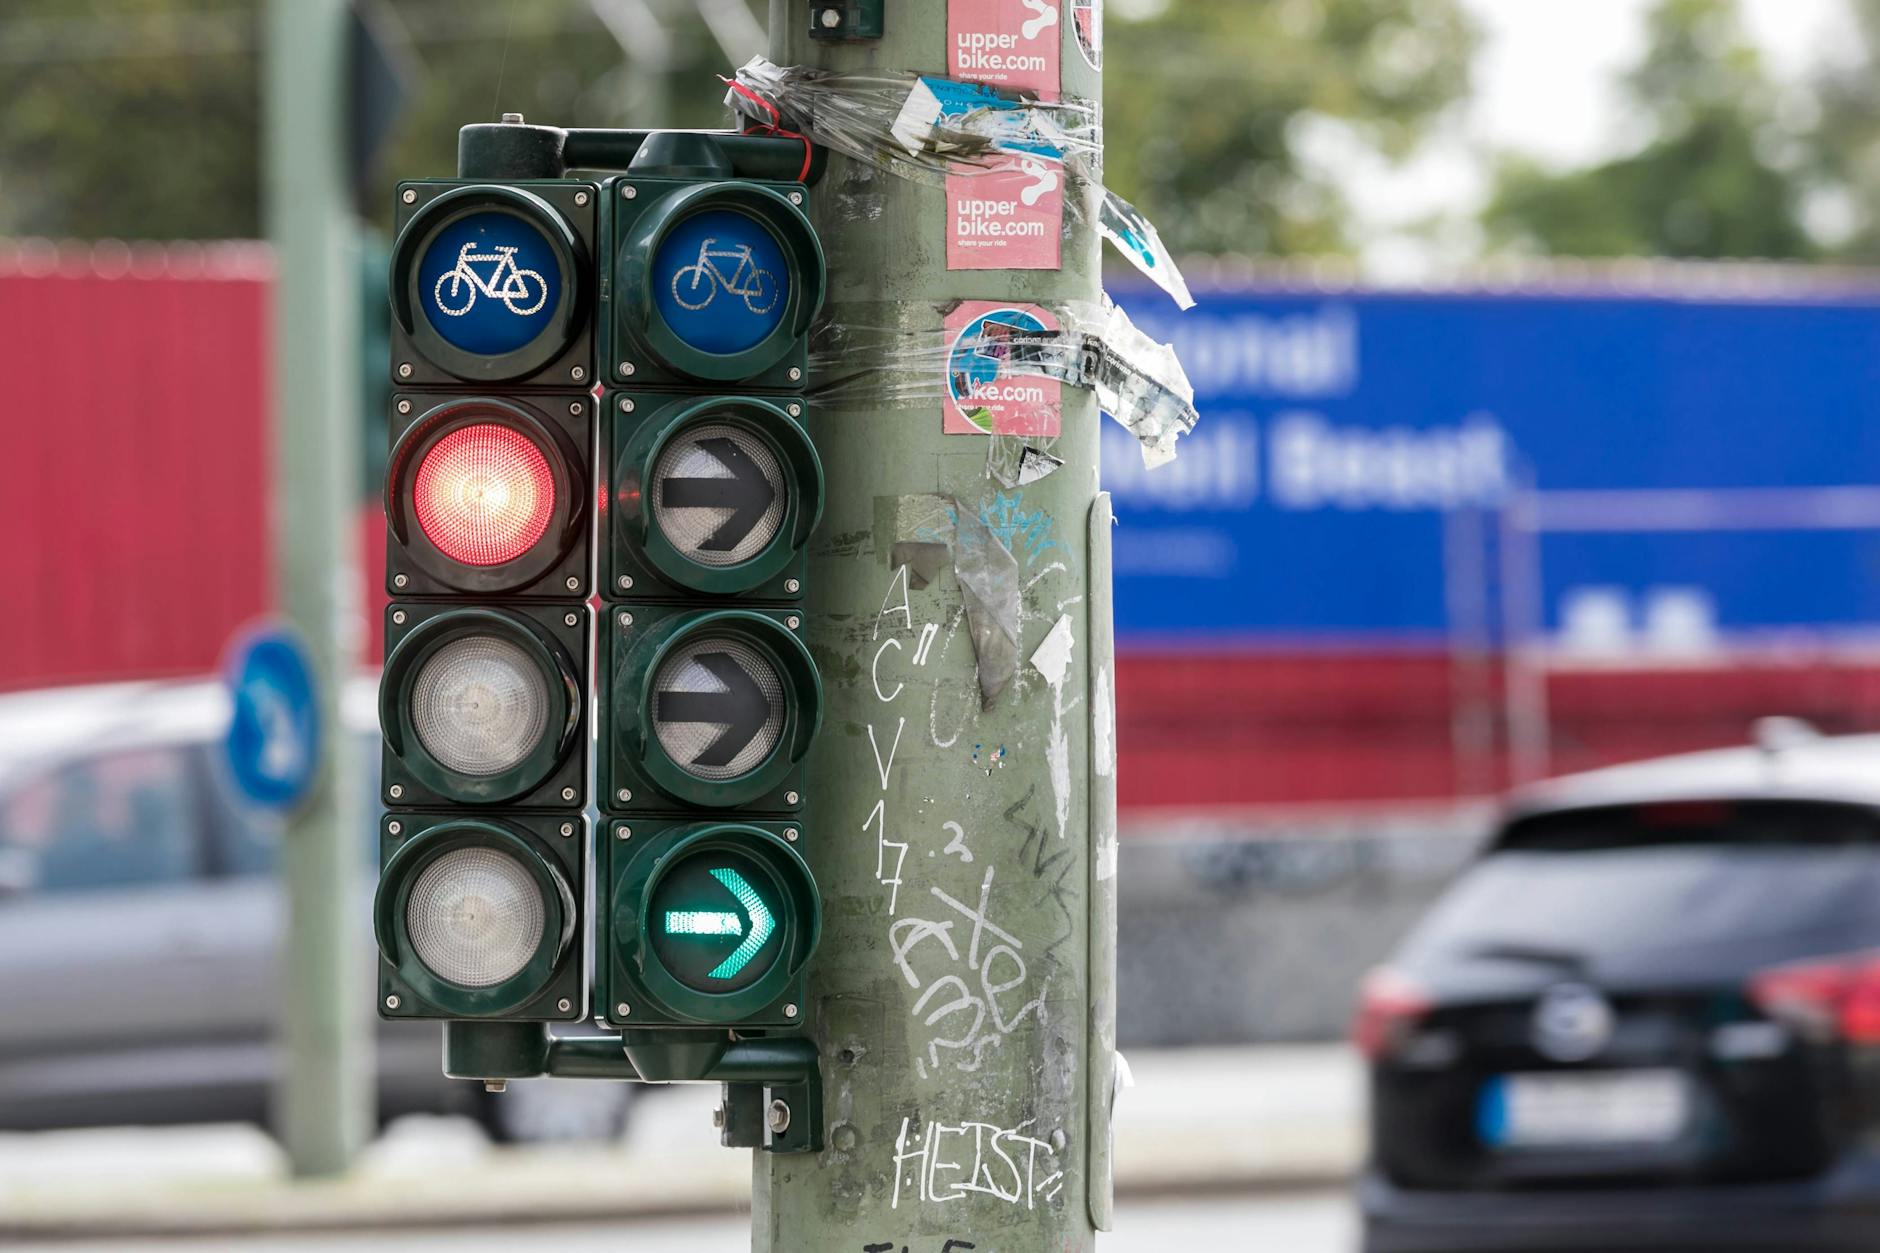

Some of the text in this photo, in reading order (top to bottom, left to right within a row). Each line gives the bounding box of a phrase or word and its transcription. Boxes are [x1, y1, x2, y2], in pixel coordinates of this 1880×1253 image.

[957, 32, 1018, 53] upper
[957, 51, 1046, 71] bike.com
[958, 72, 978, 80] share
[994, 73, 1008, 81] ride
[957, 200, 1018, 219] upper
[957, 217, 1044, 236] bike.com
